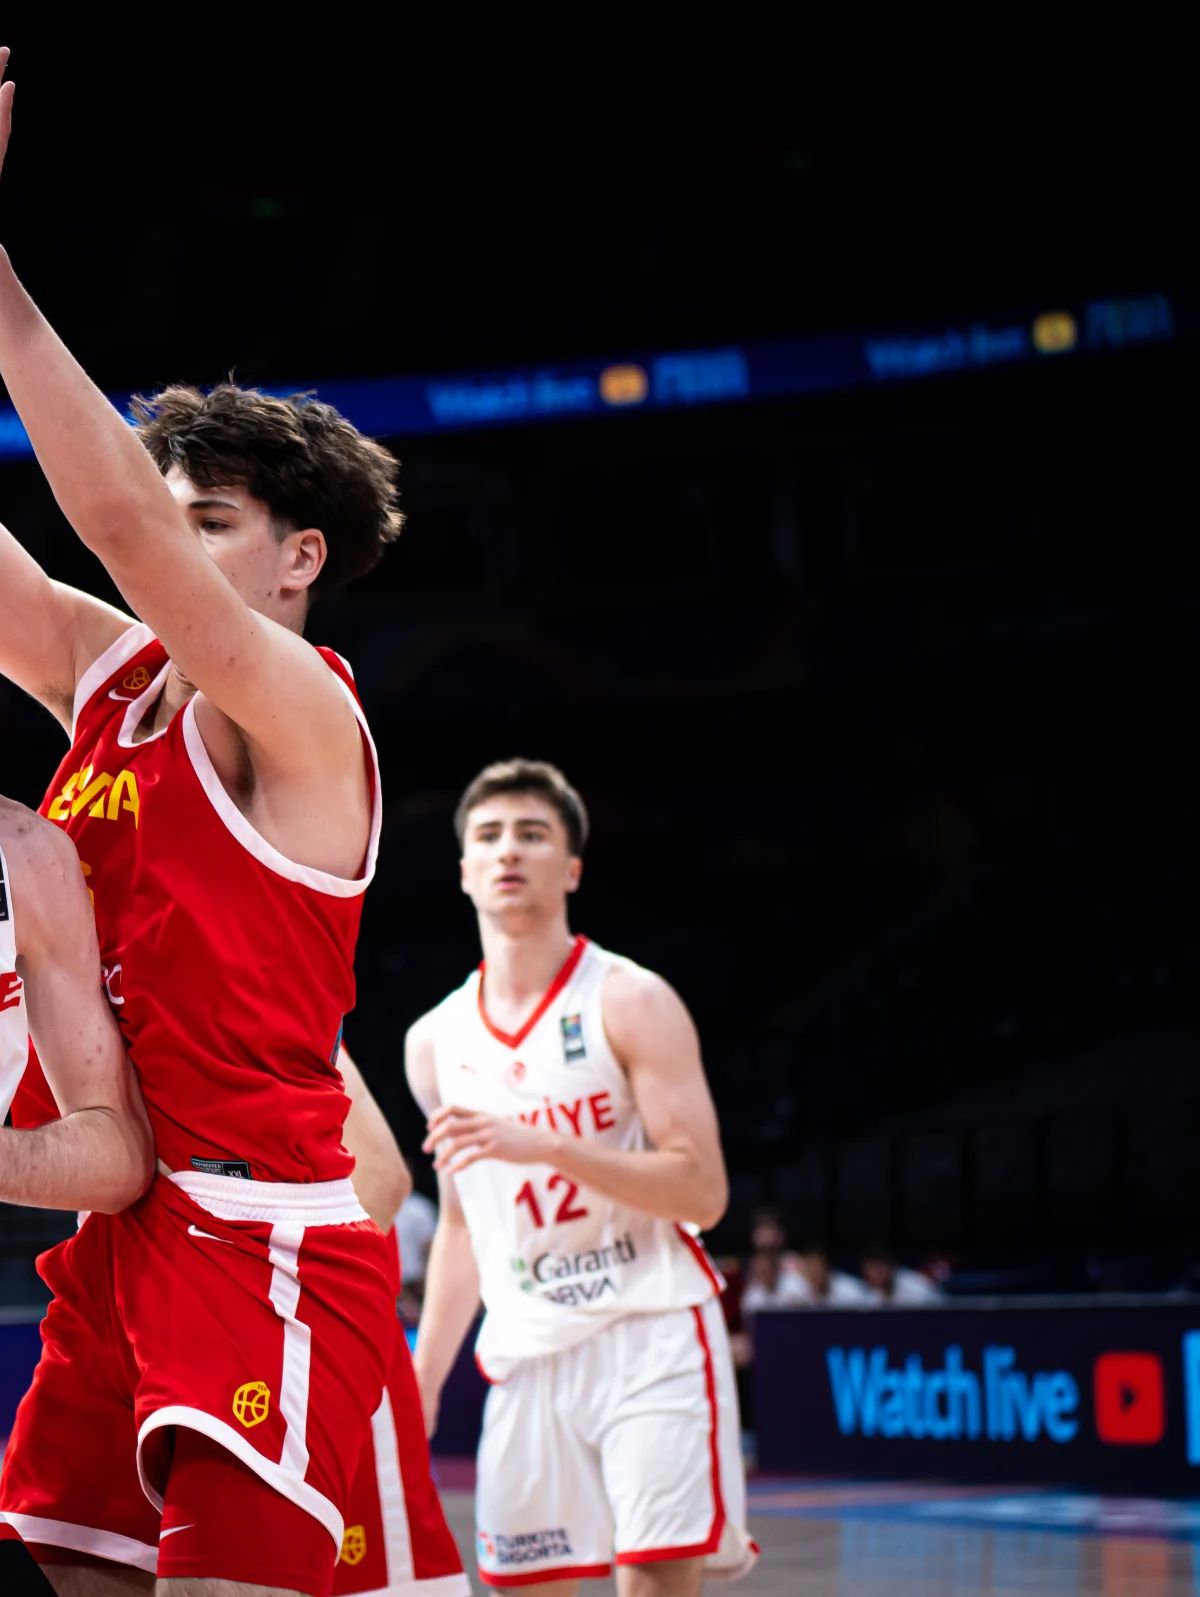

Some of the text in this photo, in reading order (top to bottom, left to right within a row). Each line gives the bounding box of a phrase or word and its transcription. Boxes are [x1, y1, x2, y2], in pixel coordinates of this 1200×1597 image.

[515, 1172, 588, 1228] 12
[825, 1345, 982, 1440] Watch
[984, 1345, 1080, 1443] live
